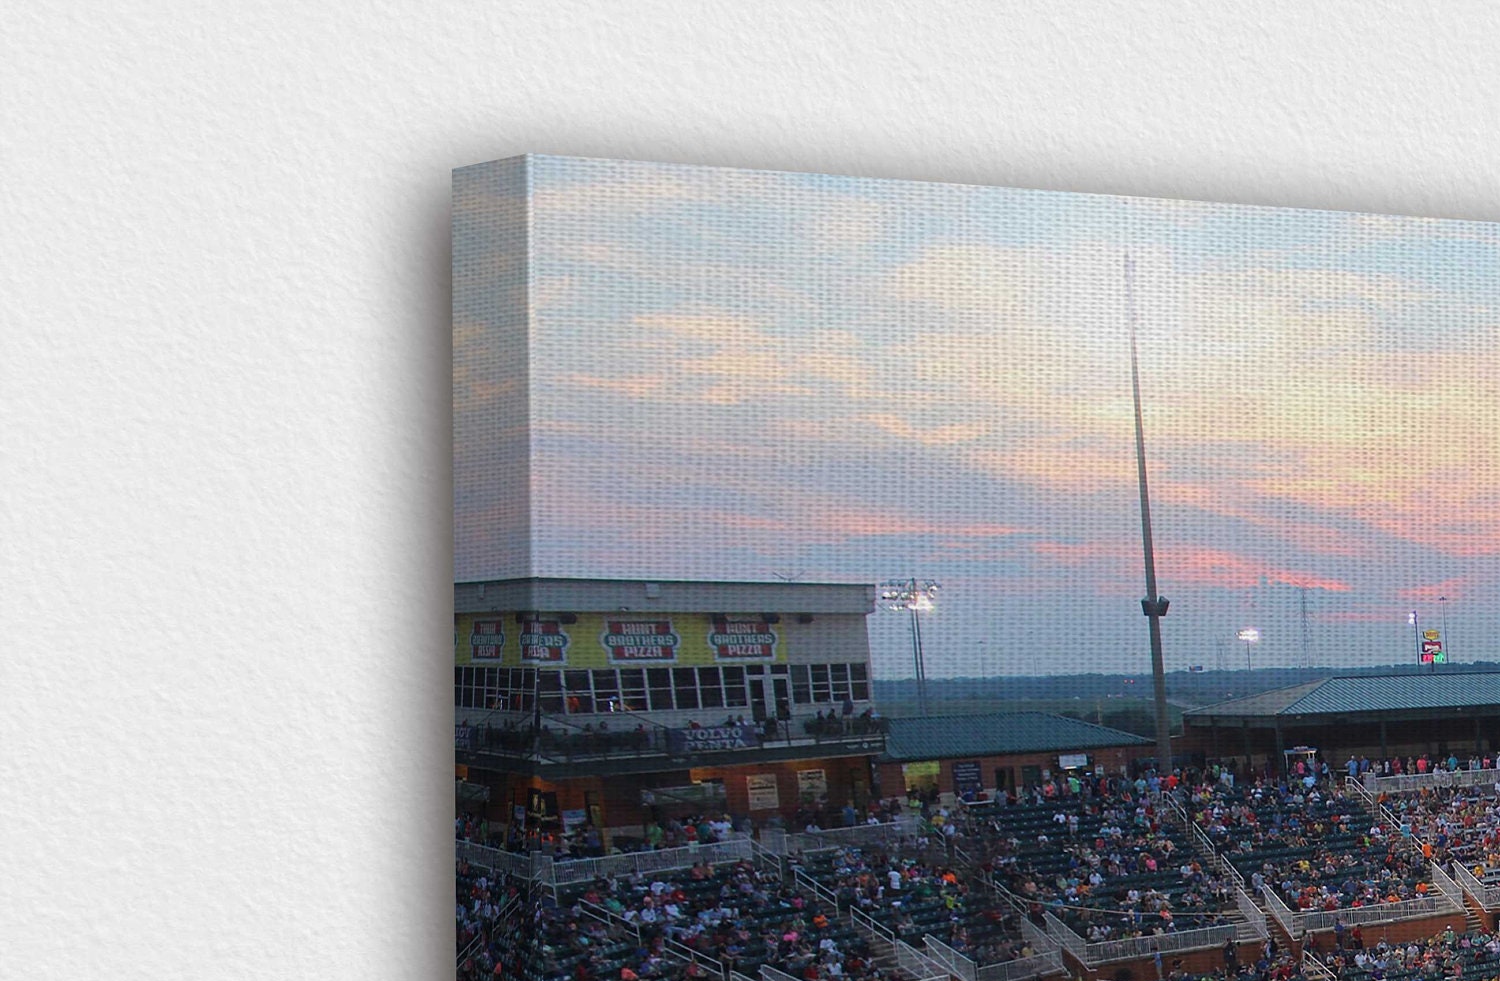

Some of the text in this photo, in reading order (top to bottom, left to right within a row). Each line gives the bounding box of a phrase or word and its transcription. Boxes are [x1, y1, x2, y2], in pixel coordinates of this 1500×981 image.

[622, 623, 658, 635] HUNT
[726, 622, 758, 634] HUNT
[608, 634, 674, 646] BROTHERS
[714, 634, 773, 645] BROTHERS
[623, 645, 662, 658] PIZZA
[728, 645, 762, 656] PIZZA
[682, 727, 742, 740] VOLVO
